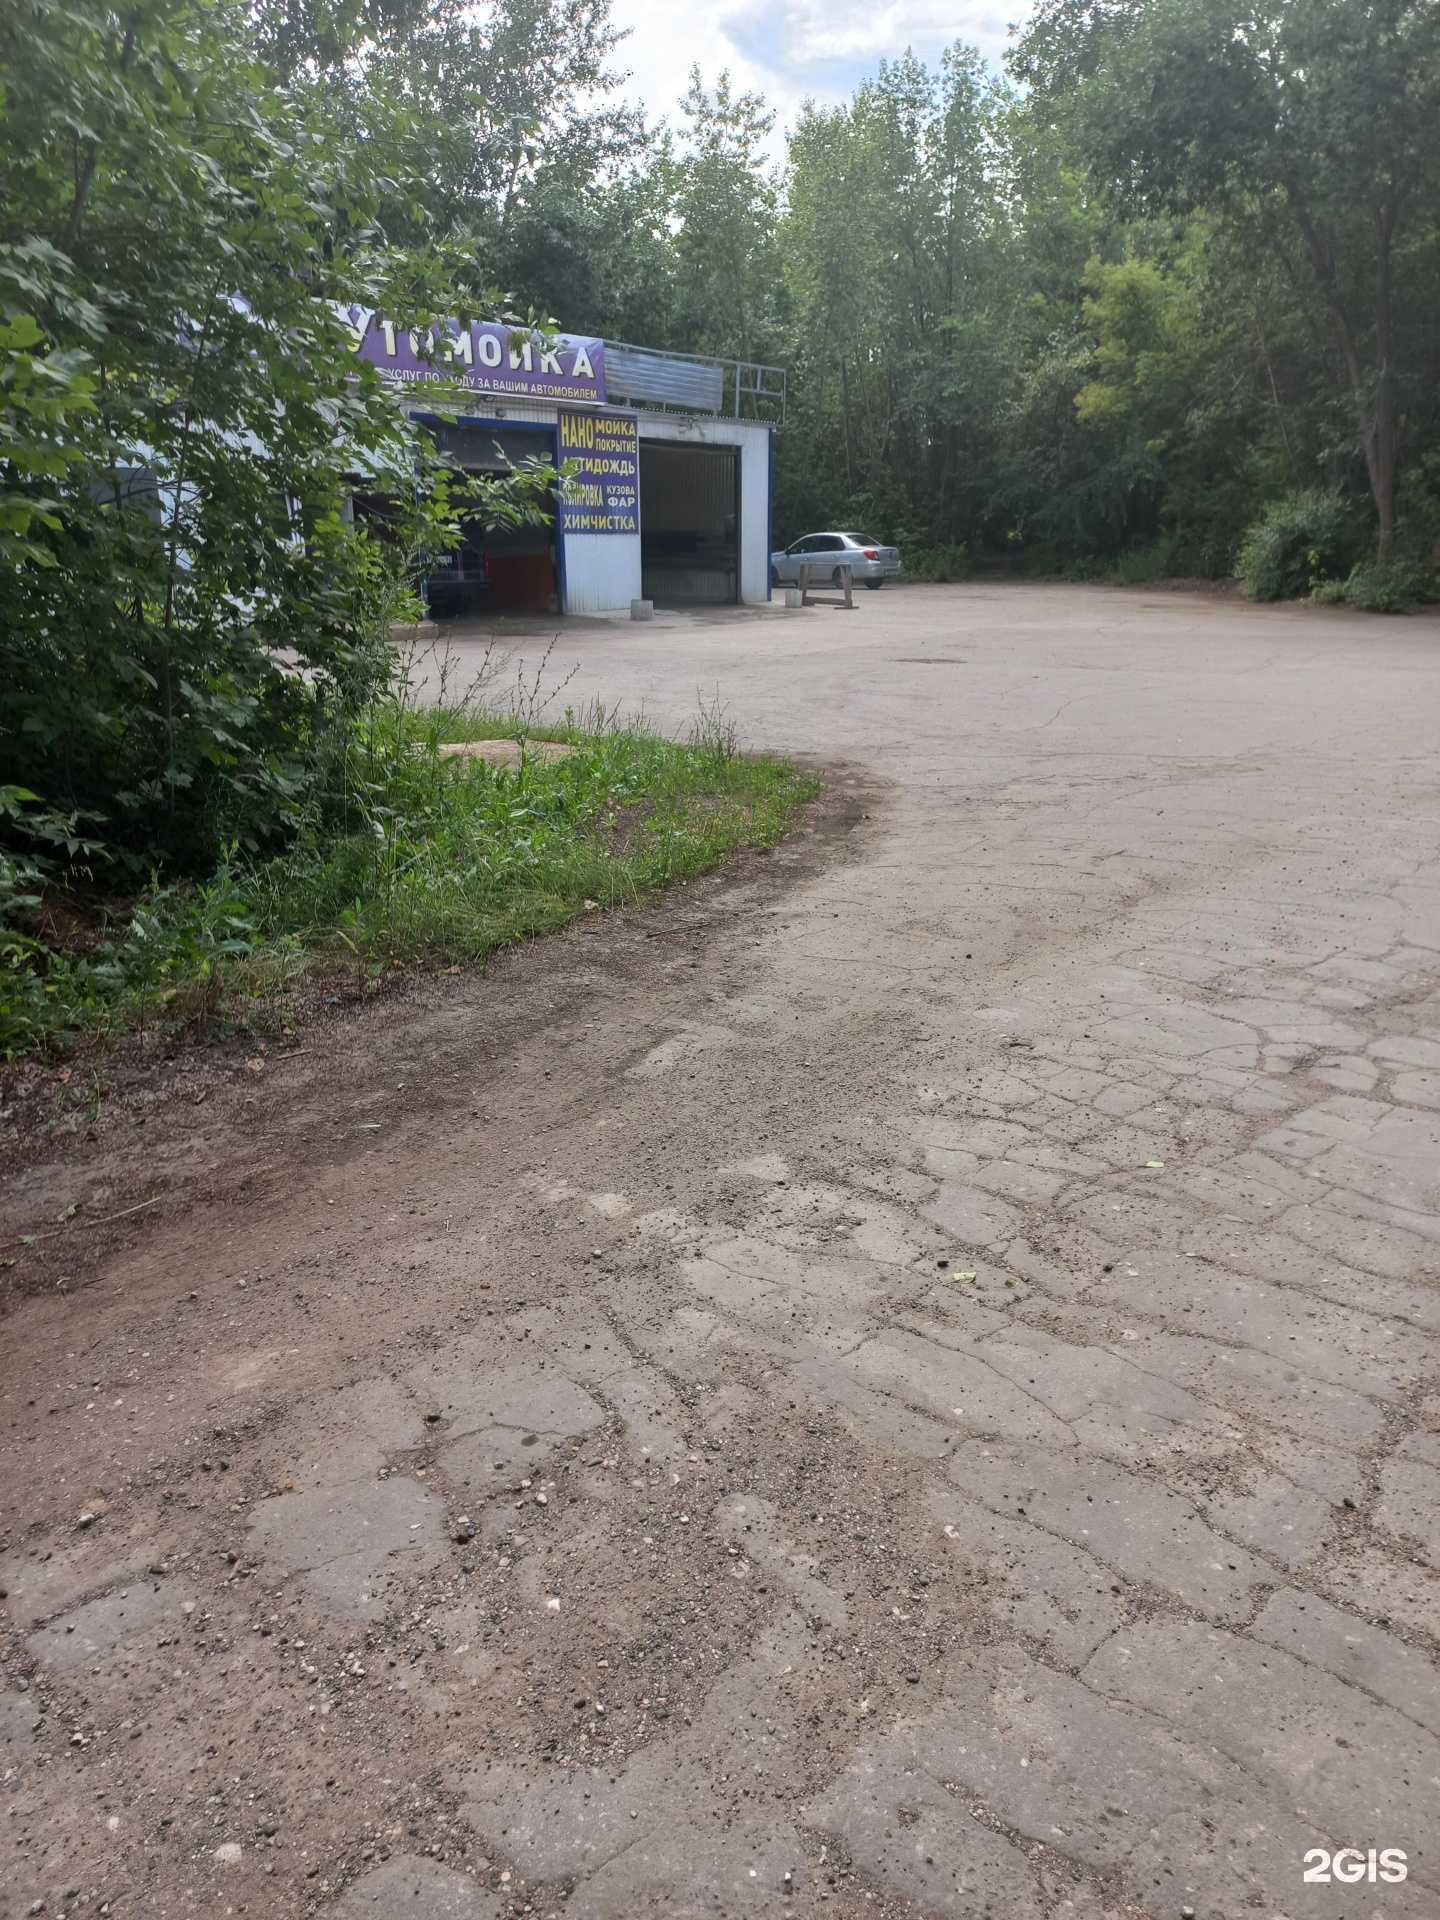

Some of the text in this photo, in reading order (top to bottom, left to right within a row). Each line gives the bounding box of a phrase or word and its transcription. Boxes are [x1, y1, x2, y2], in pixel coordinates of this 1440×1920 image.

[424, 371, 440, 384] ПО
[478, 377, 490, 389] ЗА
[492, 378, 529, 392] ВАШИМ
[530, 383, 597, 400] АВТОМОБИЛЕМ
[561, 415, 594, 449] НАНО
[595, 438, 636, 453] ПОКРЫТИЕ
[563, 456, 635, 477] АТИДОЖДЬ
[606, 485, 635, 496] КУЗОВА
[607, 496, 636, 508] ФАР
[563, 514, 636, 530] ХИМЧИСТКА
